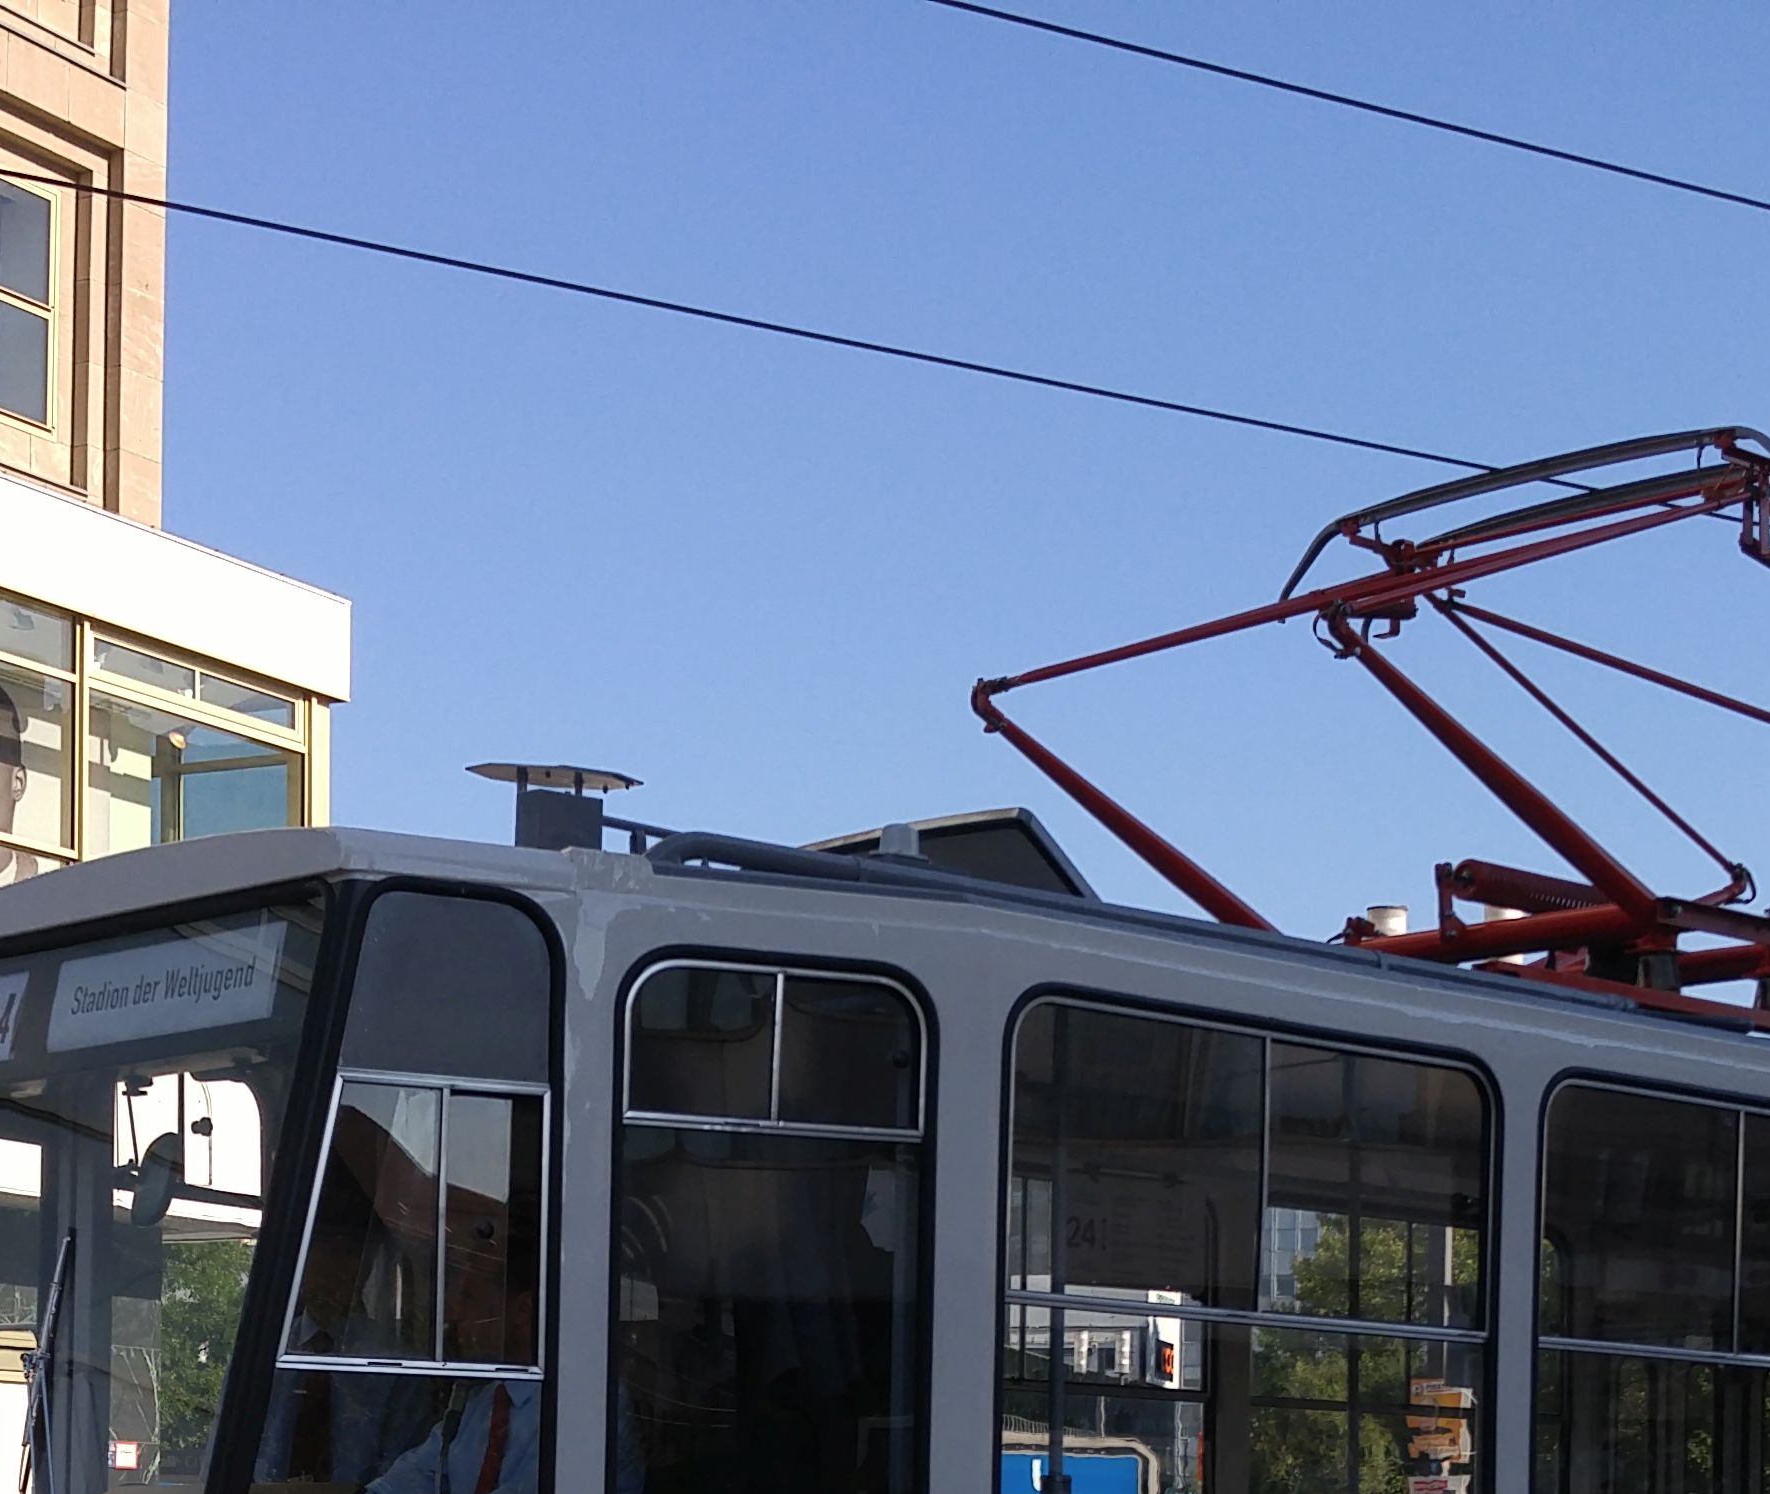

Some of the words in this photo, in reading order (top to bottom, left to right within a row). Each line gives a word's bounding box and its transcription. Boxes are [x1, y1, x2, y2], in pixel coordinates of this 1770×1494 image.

[70, 979, 129, 1015] Stadion
[132, 975, 161, 1006] der
[163, 955, 256, 1004] Weltjugend
[1067, 1215, 1097, 1249] 24
